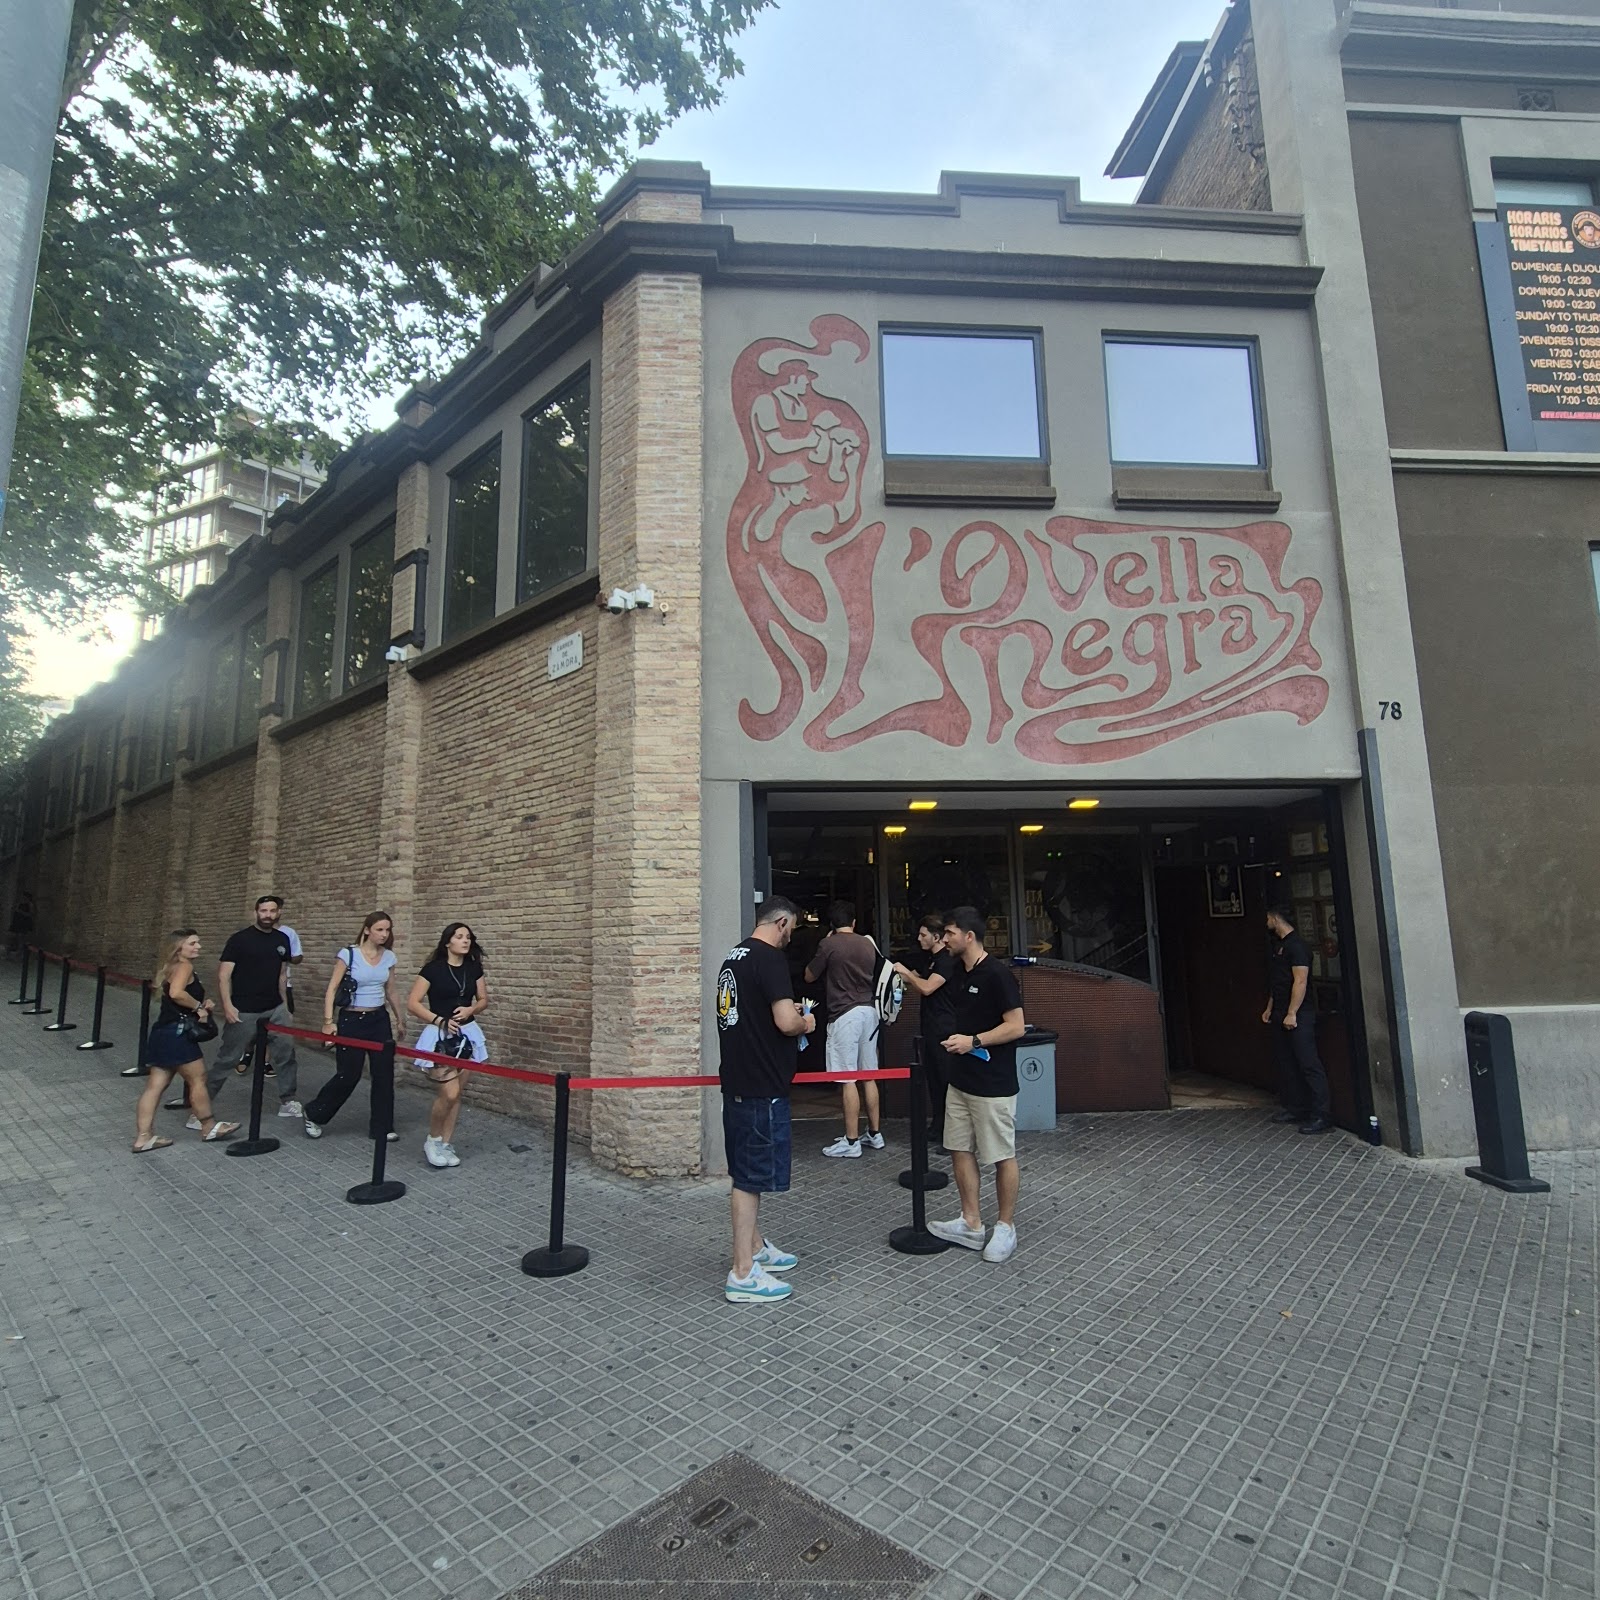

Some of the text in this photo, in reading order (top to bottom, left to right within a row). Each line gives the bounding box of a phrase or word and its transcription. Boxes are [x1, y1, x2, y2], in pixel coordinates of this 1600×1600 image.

[1506, 210, 1562, 226] HORARIS
[1508, 224, 1568, 240] HORARIOS
[1510, 238, 1575, 253] TIMETABLE
[1511, 261, 1563, 273] DIUMENGE
[1563, 263, 1572, 273] A
[1537, 274, 1561, 284] 19:00
[1567, 275, 1592, 285] 02:30
[1518, 286, 1566, 297] DOMINGO
[1567, 287, 1575, 297] A
[1541, 299, 1566, 309] 19:00
[1571, 299, 1596, 310] 02:30
[1515, 311, 1556, 321] SUNDAY
[1556, 312, 1571, 322] TO
[1545, 323, 1569, 333] 19:00
[1575, 324, 1600, 334] 02:30
[1519, 336, 1574, 346] DIVENDRES
[1549, 348, 1573, 358] 17:00
[1530, 359, 1573, 369] VIERNES
[1573, 360, 1581, 369] Y
[1552, 371, 1577, 381] 17:00
[1526, 383, 1562, 394] FRIDAY
[1563, 385, 1582, 395] and
[1556, 395, 1581, 405] 17:00
[556, 639, 574, 652] CARRER
[561, 650, 568, 658] DE
[552, 655, 578, 673] ZAMORA
[1378, 701, 1403, 721] 78
